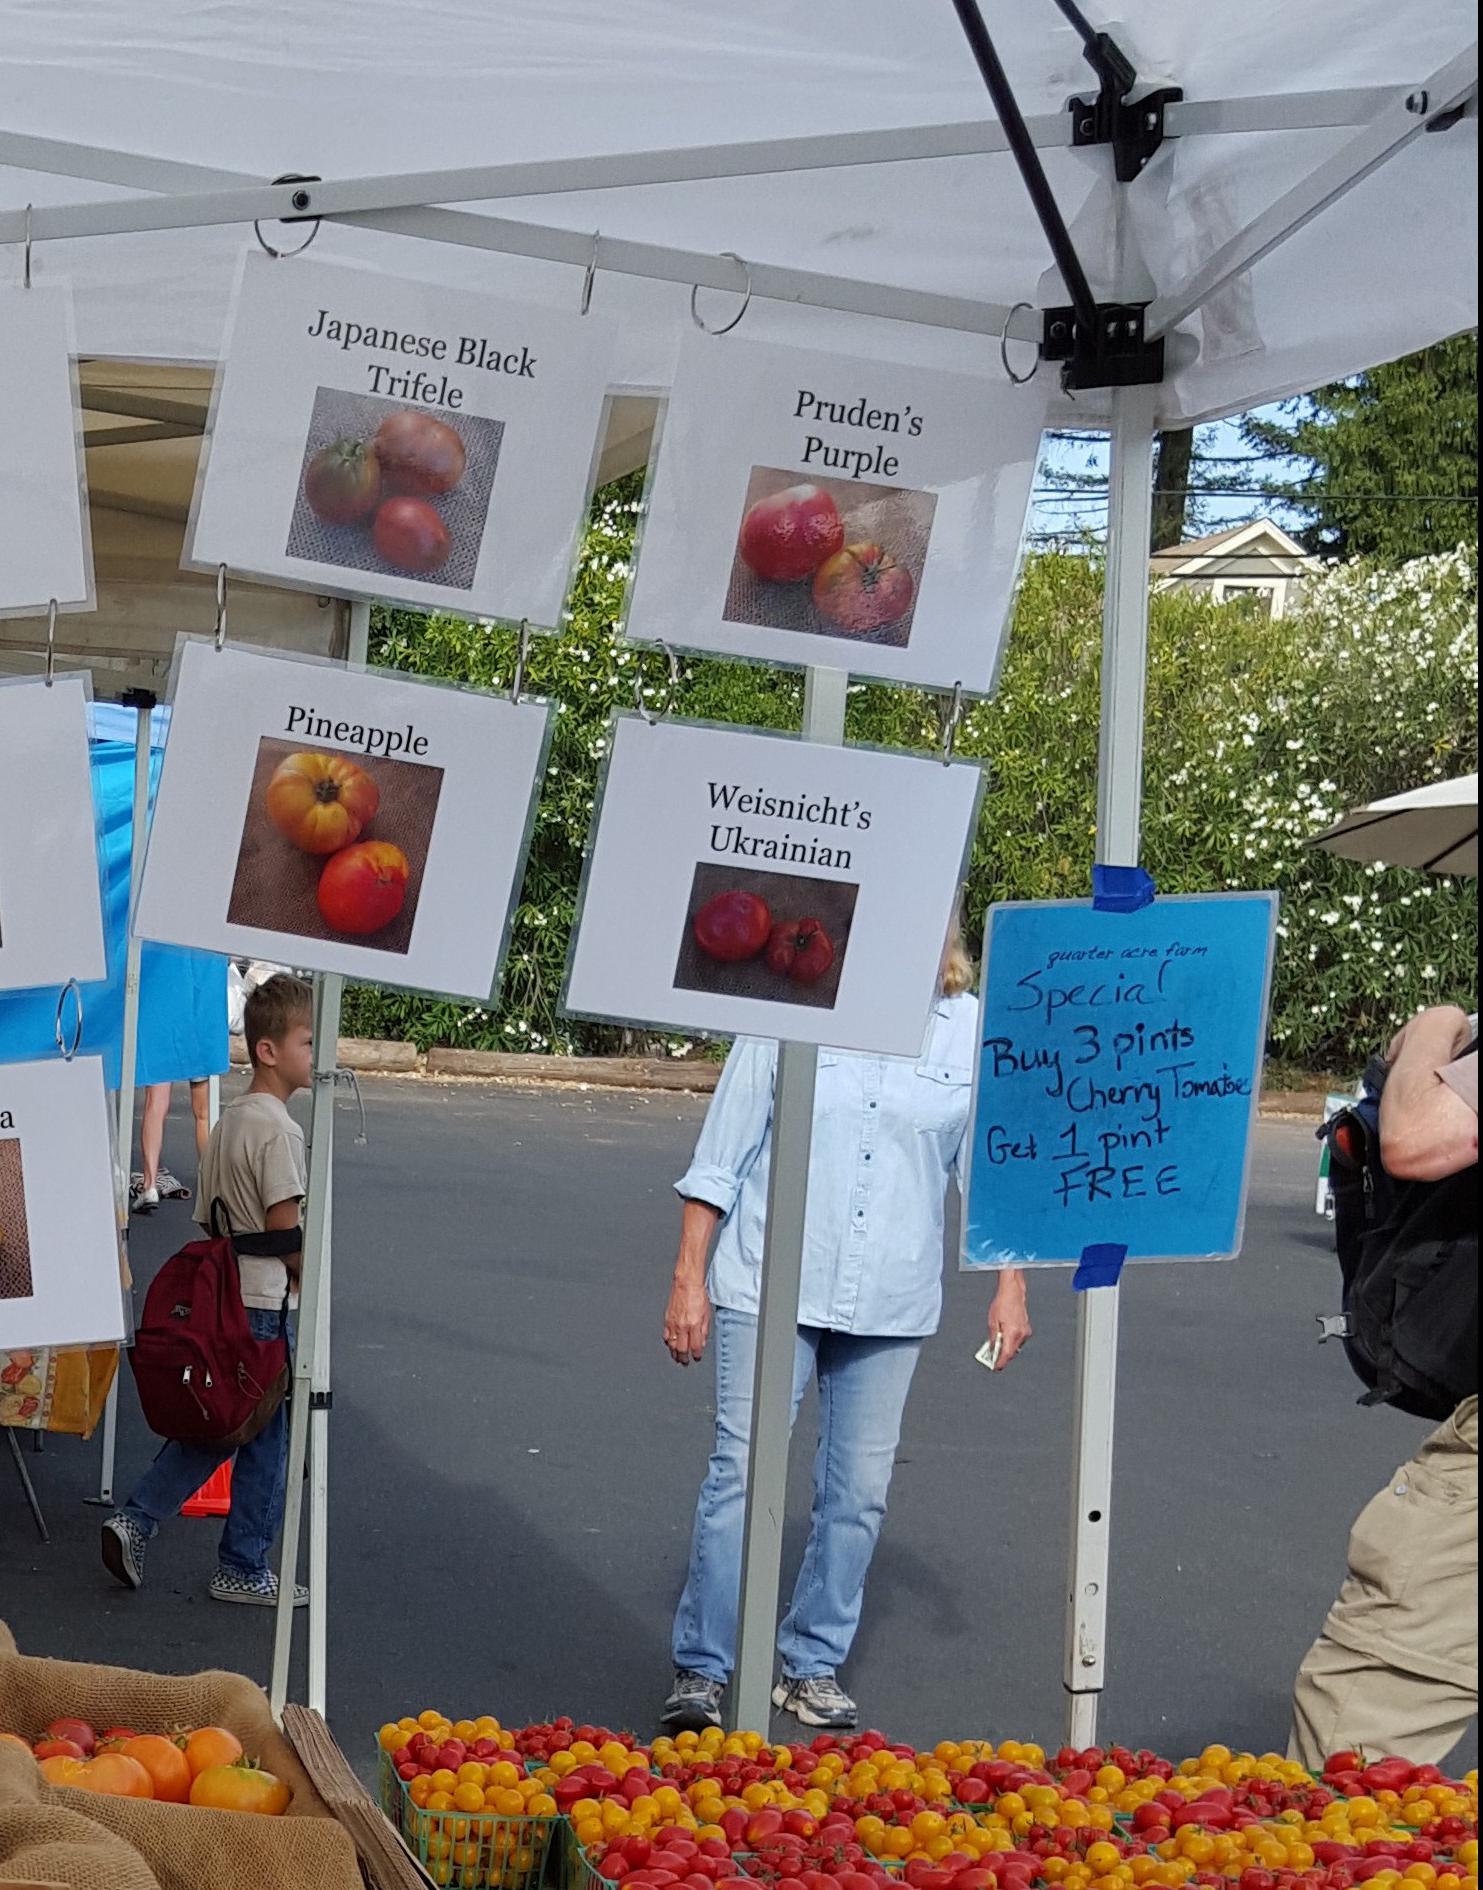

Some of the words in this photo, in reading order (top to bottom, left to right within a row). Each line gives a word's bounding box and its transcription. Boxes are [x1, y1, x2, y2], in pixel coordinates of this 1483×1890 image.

[308, 310, 447, 360] Japanese
[455, 337, 537, 378] Black
[368, 365, 463, 409] Trifele
[793, 390, 923, 436] Pruden’s
[801, 436, 898, 479] Purple
[284, 706, 428, 758] Pineapple
[708, 782, 872, 830] Weisnicht’s
[710, 825, 851, 869] Ukrainian
[1047, 946, 1114, 969] quarter
[1121, 948, 1158, 959] acre
[1166, 942, 1208, 957] farm
[1007, 959, 1172, 1025] Special
[984, 1037, 1063, 1097] Buy
[1074, 1025, 1101, 1065] 3
[1113, 1019, 1195, 1073] pints
[1066, 1076, 1161, 1121] Cherry
[987, 1125, 1038, 1164] Get
[1052, 1122, 1089, 1161] 1
[1099, 1117, 1171, 1167] pint
[1053, 1161, 1181, 1208] FREE
